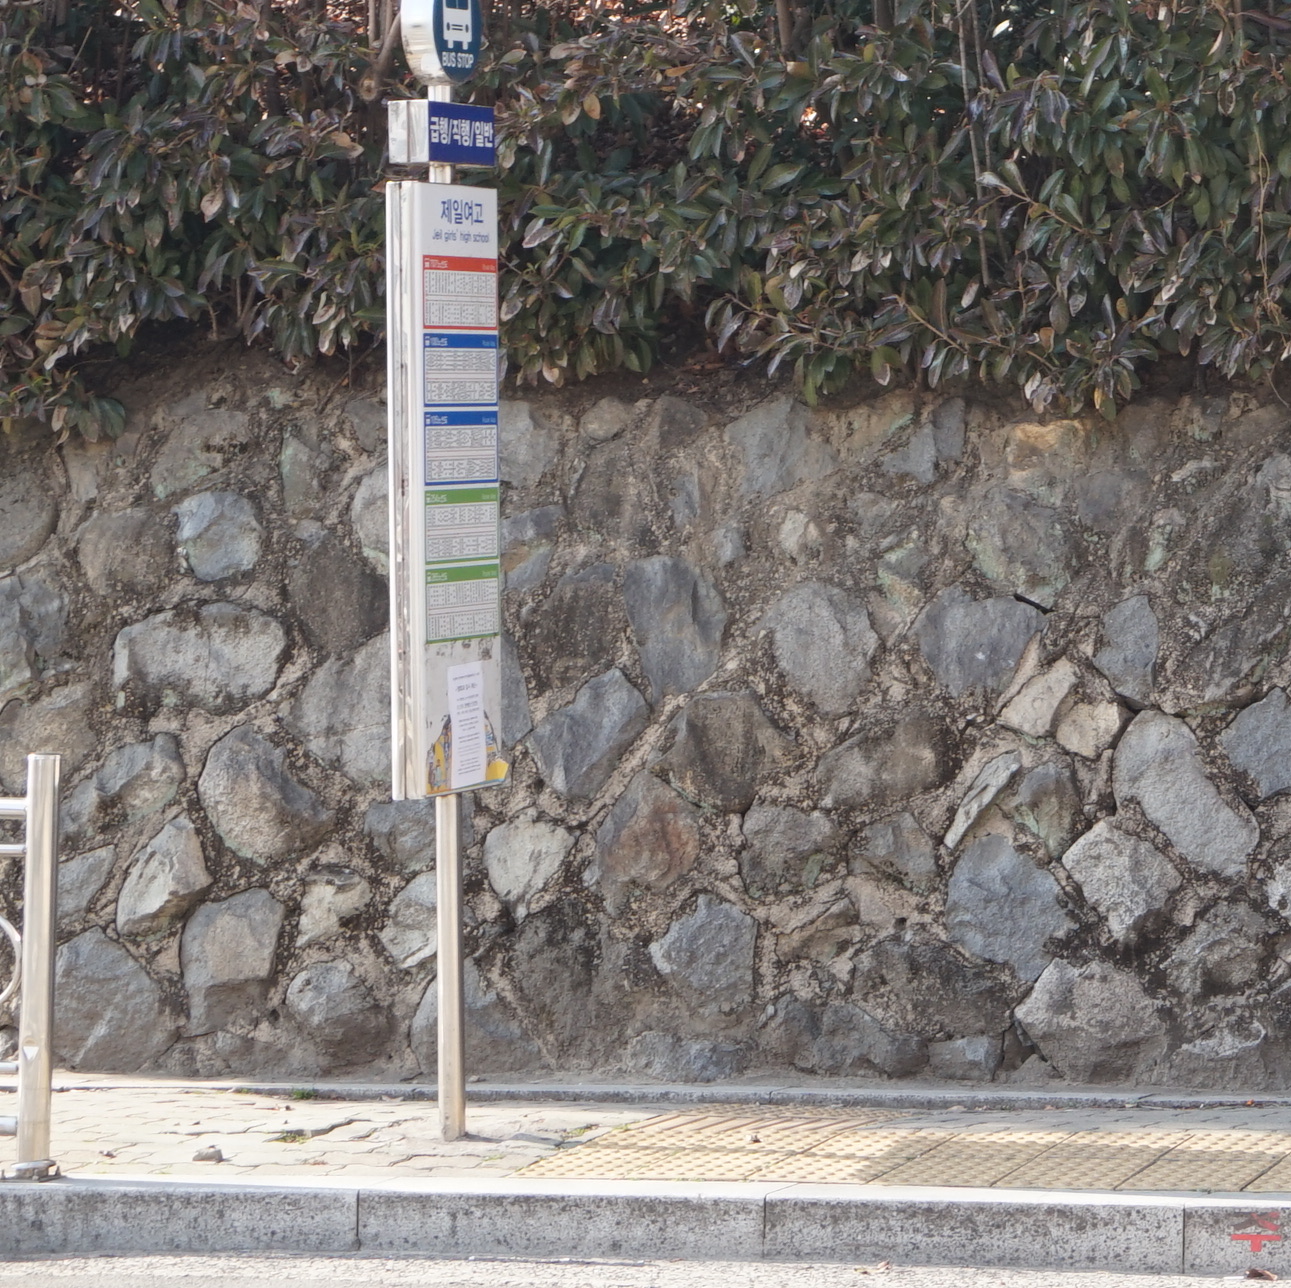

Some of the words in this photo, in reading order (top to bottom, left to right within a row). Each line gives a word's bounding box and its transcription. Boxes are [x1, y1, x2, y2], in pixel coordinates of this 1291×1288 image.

[442, 51, 456, 67] BUS
[457, 52, 474, 68] STOP
[430, 117, 493, 148] 급행/직행/일반
[441, 199, 484, 225] 제일여고
[432, 229, 443, 240] Jeil
[460, 230, 471, 243] high
[473, 232, 490, 243] school
